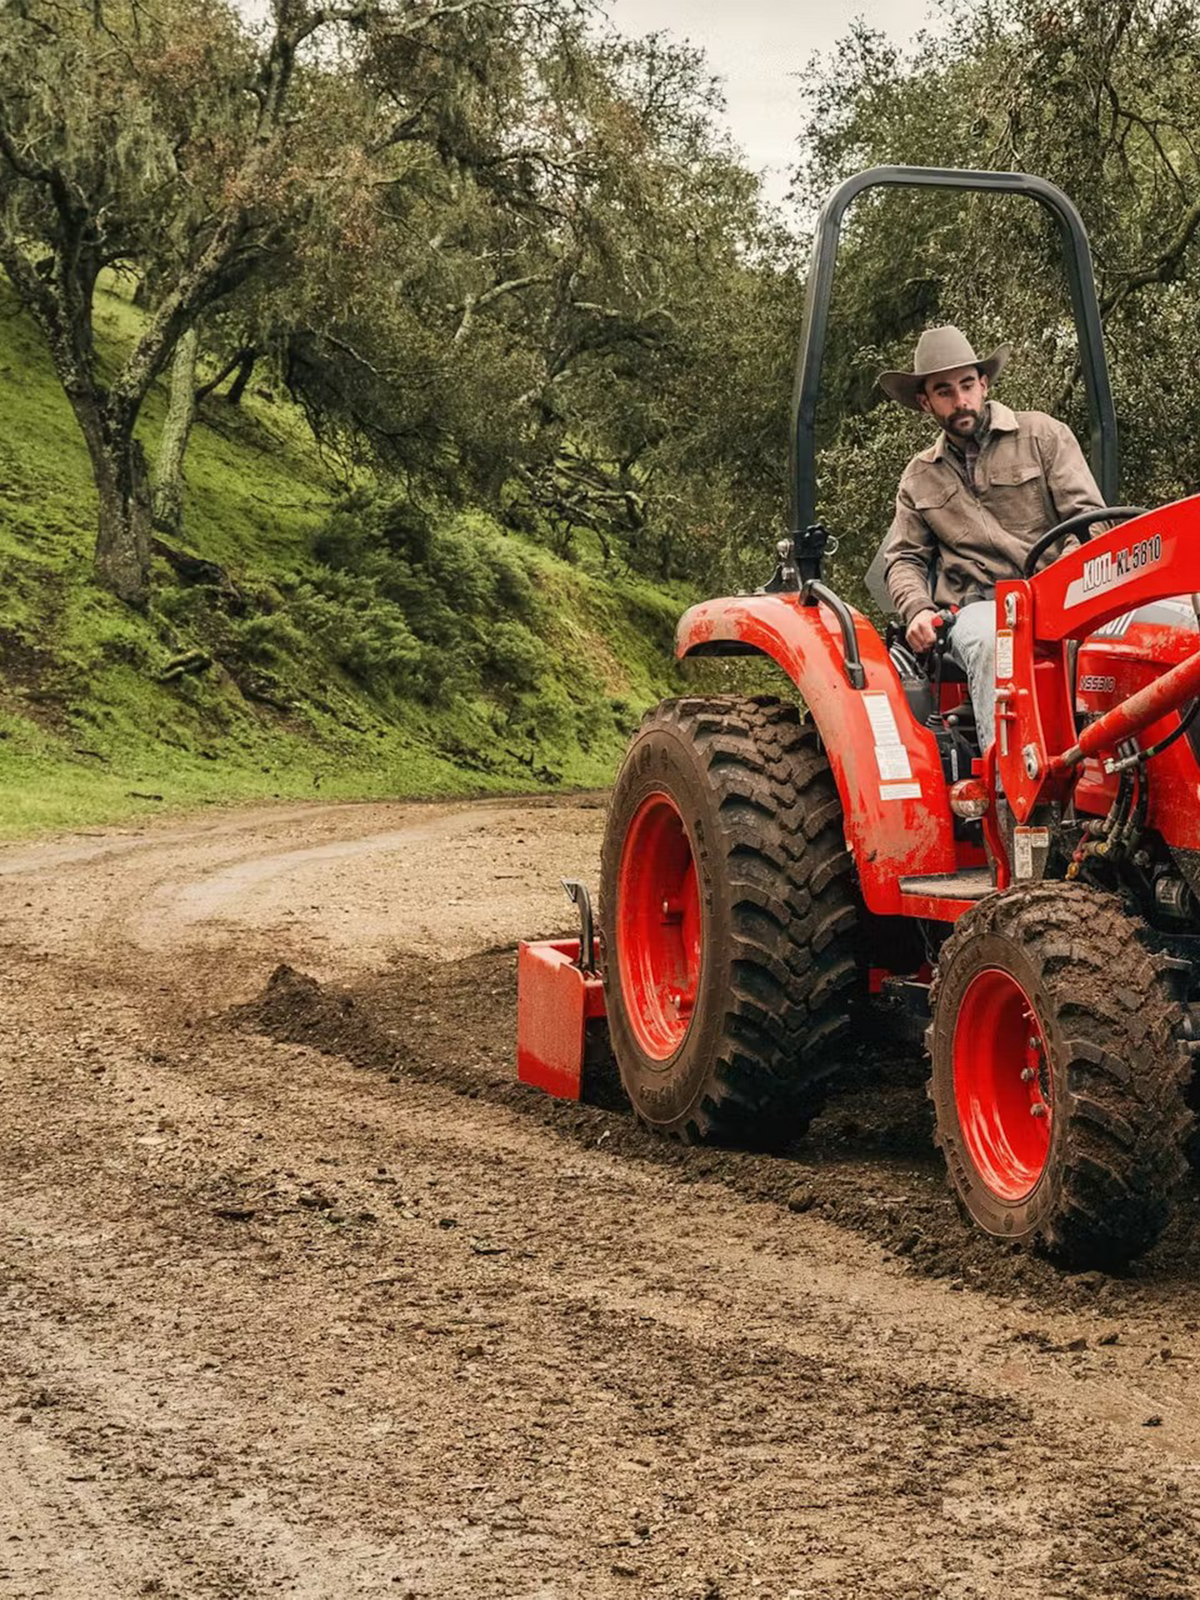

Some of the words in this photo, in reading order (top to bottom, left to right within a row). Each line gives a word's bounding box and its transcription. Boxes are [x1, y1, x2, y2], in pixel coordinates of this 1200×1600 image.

[1083, 551, 1112, 593] KIOTI
[1116, 547, 1131, 577] KL
[1132, 534, 1161, 568] 5810
